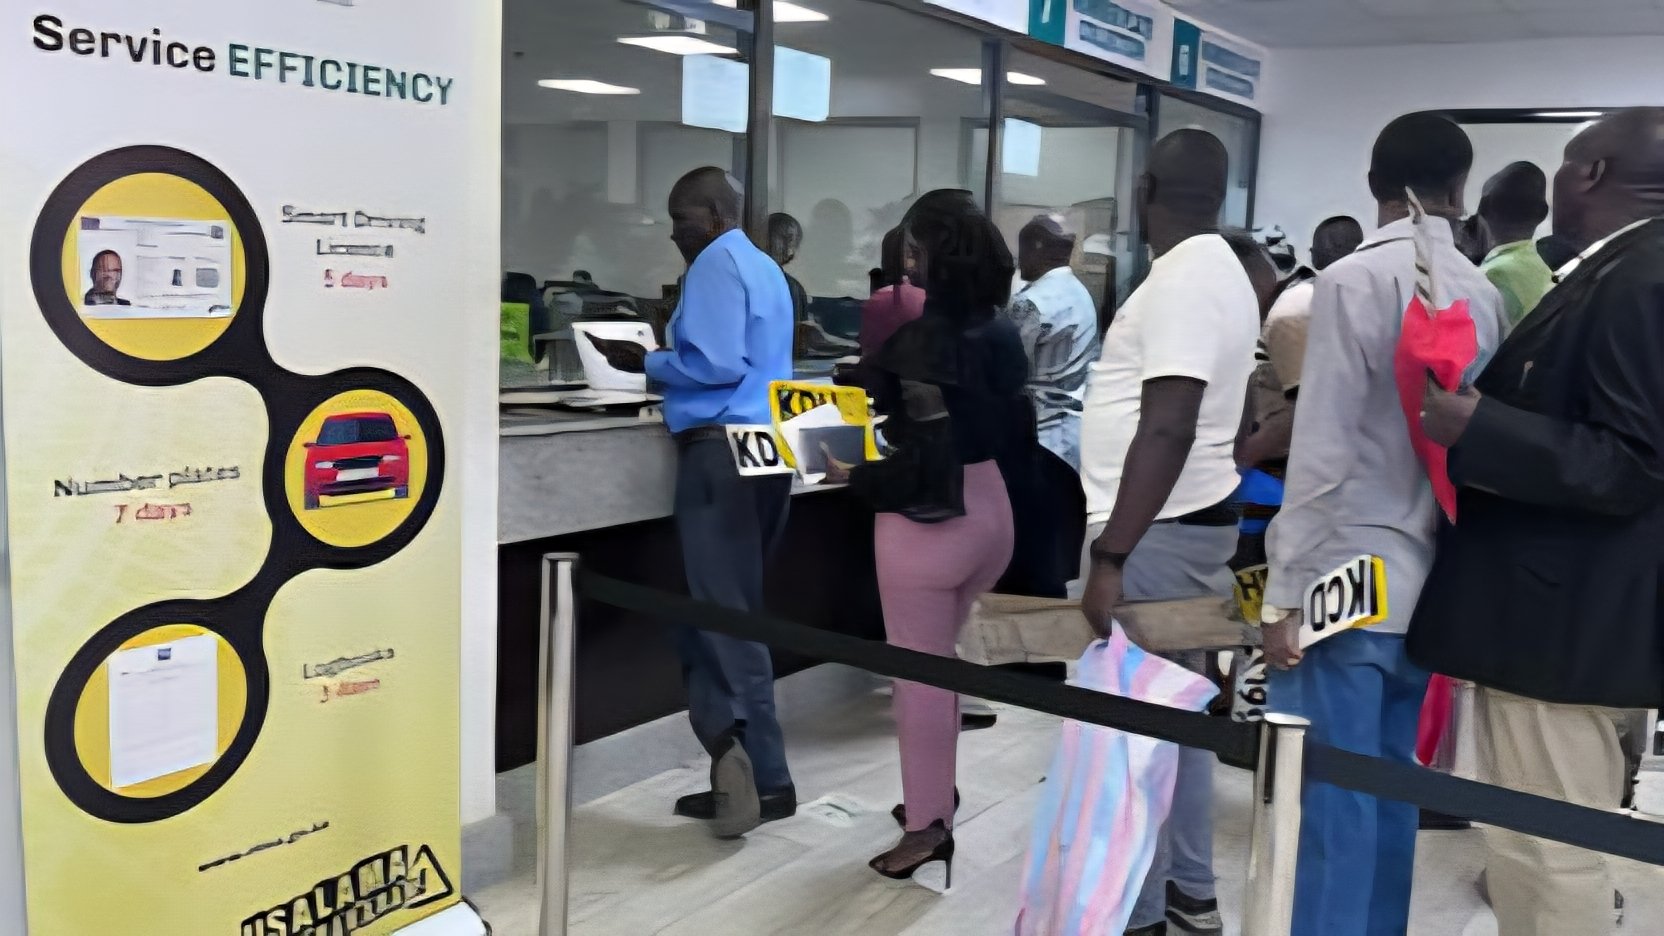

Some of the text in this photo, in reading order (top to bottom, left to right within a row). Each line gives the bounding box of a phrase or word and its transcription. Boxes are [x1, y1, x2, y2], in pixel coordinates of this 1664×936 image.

[33, 14, 453, 105] Service EFFICIENCY
[1310, 560, 1365, 631] KCD
